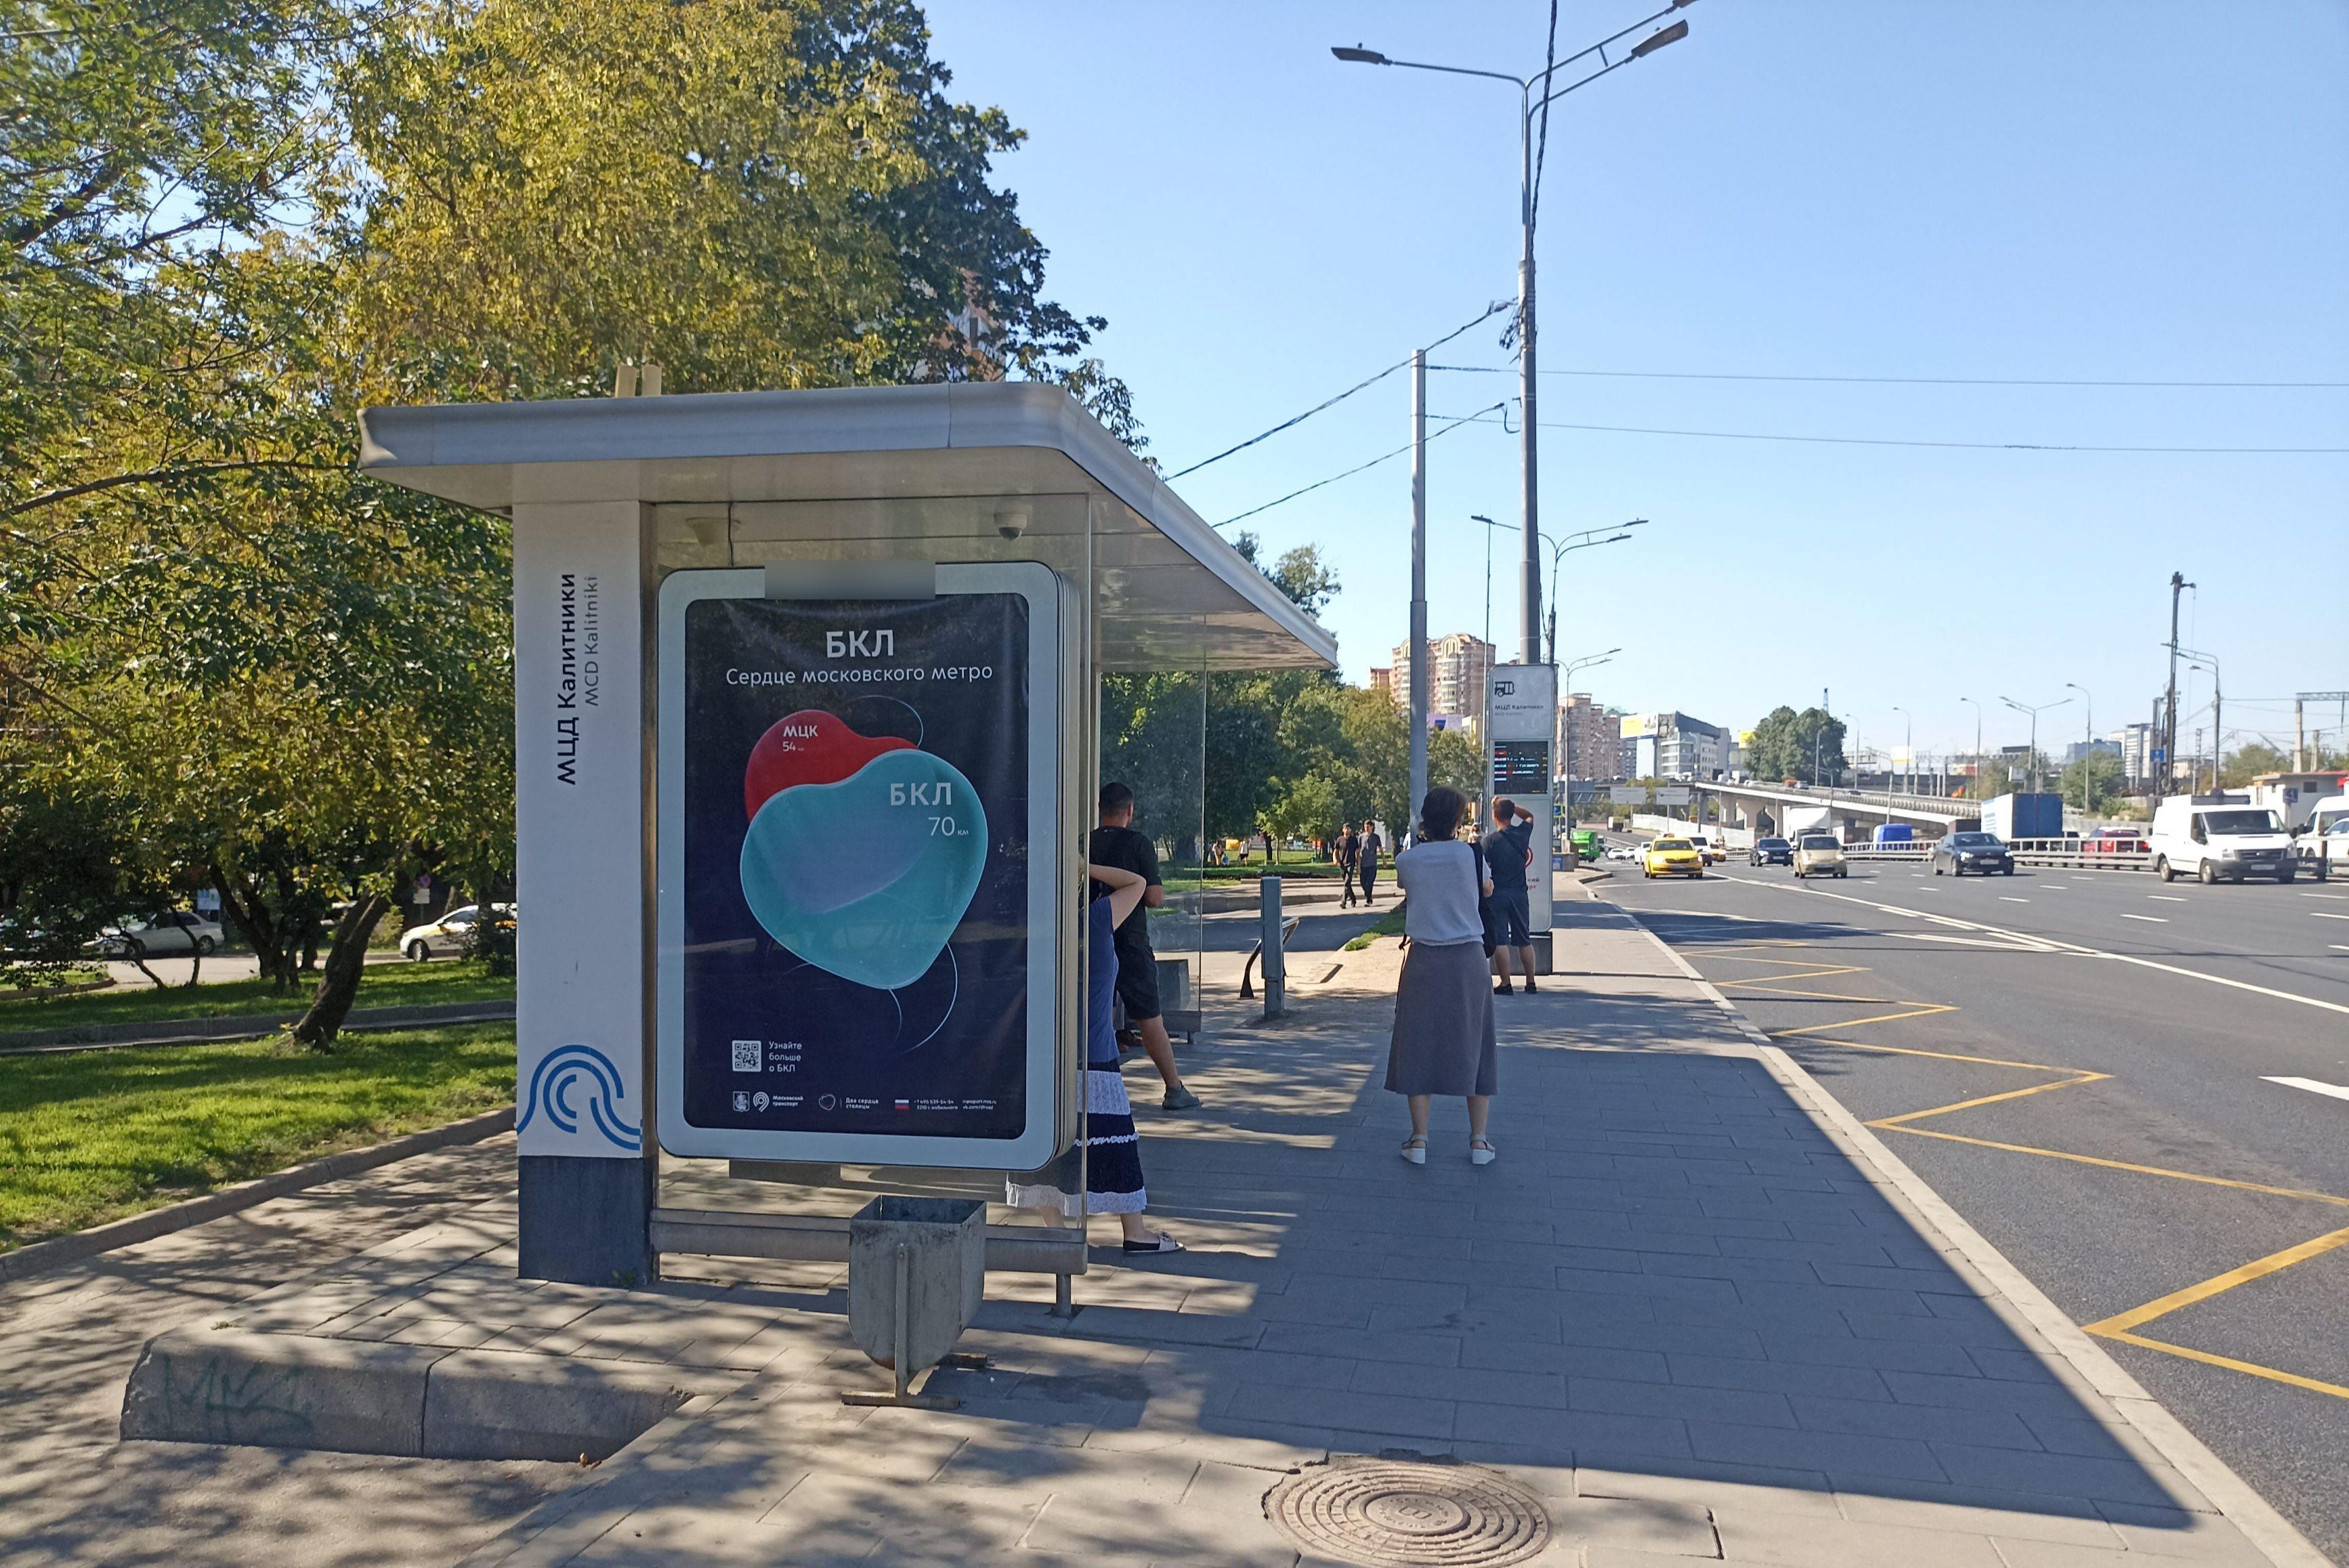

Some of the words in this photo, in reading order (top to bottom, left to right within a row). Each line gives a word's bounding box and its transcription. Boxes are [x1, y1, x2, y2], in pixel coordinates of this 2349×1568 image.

[583, 576, 599, 655] Kalitniki
[557, 574, 576, 708] Калитники
[826, 629, 894, 658] БКЛ
[585, 660, 599, 706] MCD
[726, 669, 796, 687] Сердце
[802, 667, 925, 683] московского
[931, 665, 993, 682] метро
[783, 725, 818, 739] МЦК
[557, 717, 579, 785] МЦД
[782, 741, 797, 752] 54
[890, 782, 952, 806] БКЛ
[928, 816, 955, 836] 70
[768, 1040, 803, 1050] Узнайте
[768, 1052, 802, 1061] больше
[777, 1064, 796, 1072] БКЛ
